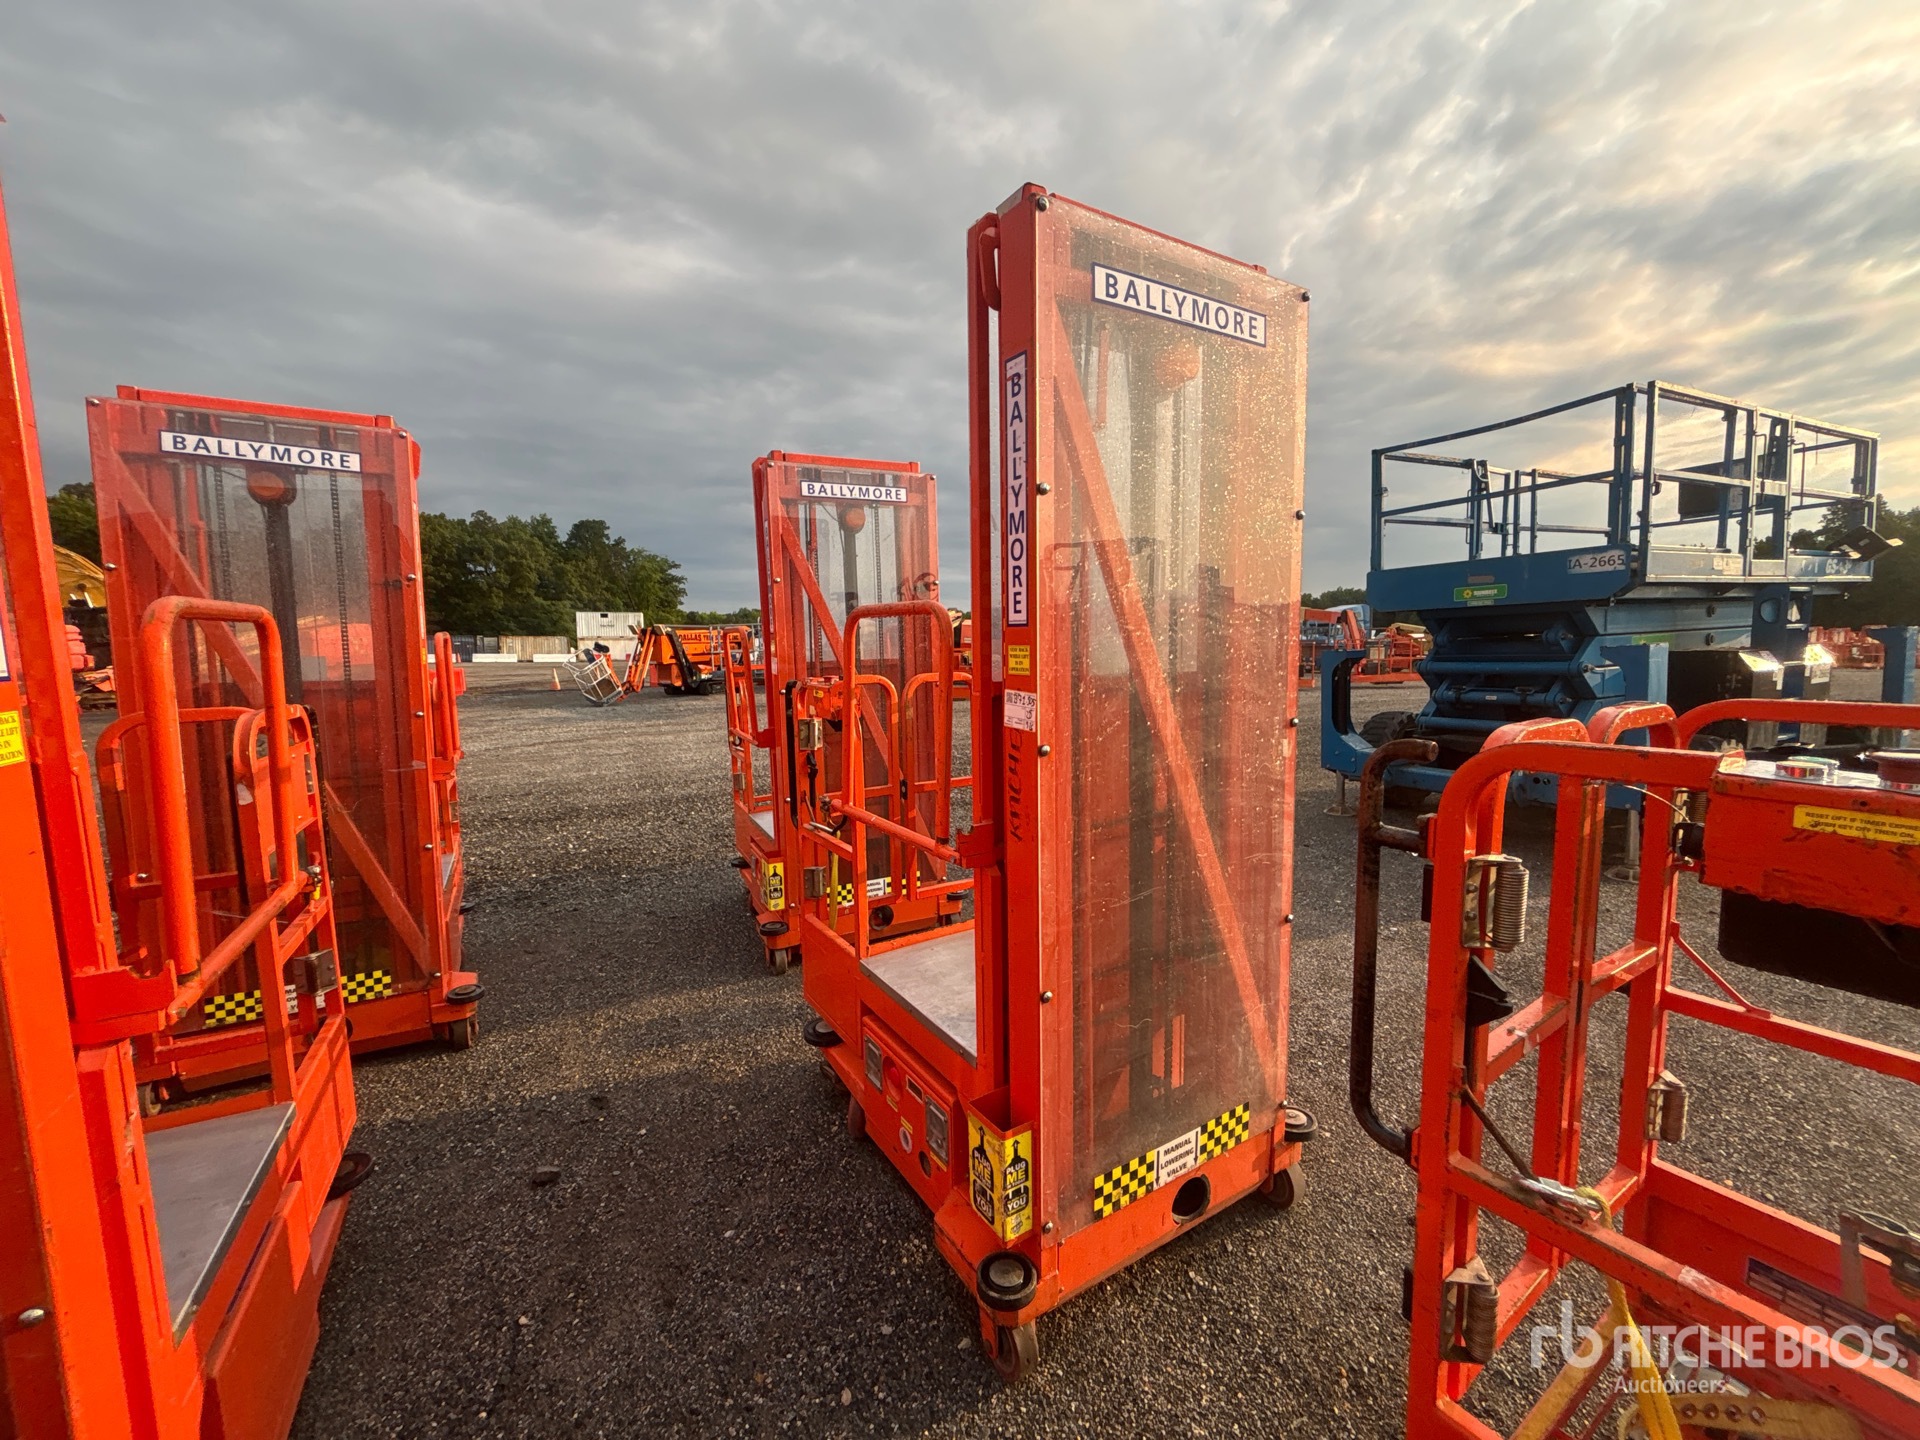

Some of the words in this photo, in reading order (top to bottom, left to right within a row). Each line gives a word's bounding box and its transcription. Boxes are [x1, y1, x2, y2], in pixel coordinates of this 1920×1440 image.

[1105, 272, 1258, 339] BALLYMORE
[172, 434, 351, 469] BALLYMORE
[807, 483, 902, 500] BALLYMORE
[1009, 372, 1025, 614] BALLYMORE
[1568, 554, 1626, 570] IA-2665
[1889, 822, 1920, 832] EXPIRE
[1163, 1137, 1192, 1156] MANUAL
[974, 1150, 991, 1171] PLUG
[1006, 1160, 1026, 1174] PLUG
[1160, 1147, 1195, 1170] LOWERING
[974, 1158, 992, 1185] ME
[1006, 1169, 1026, 1185] ME
[1166, 1161, 1188, 1178] VALVE
[976, 1193, 992, 1217] YOU
[1007, 1197, 1026, 1211] YOU
